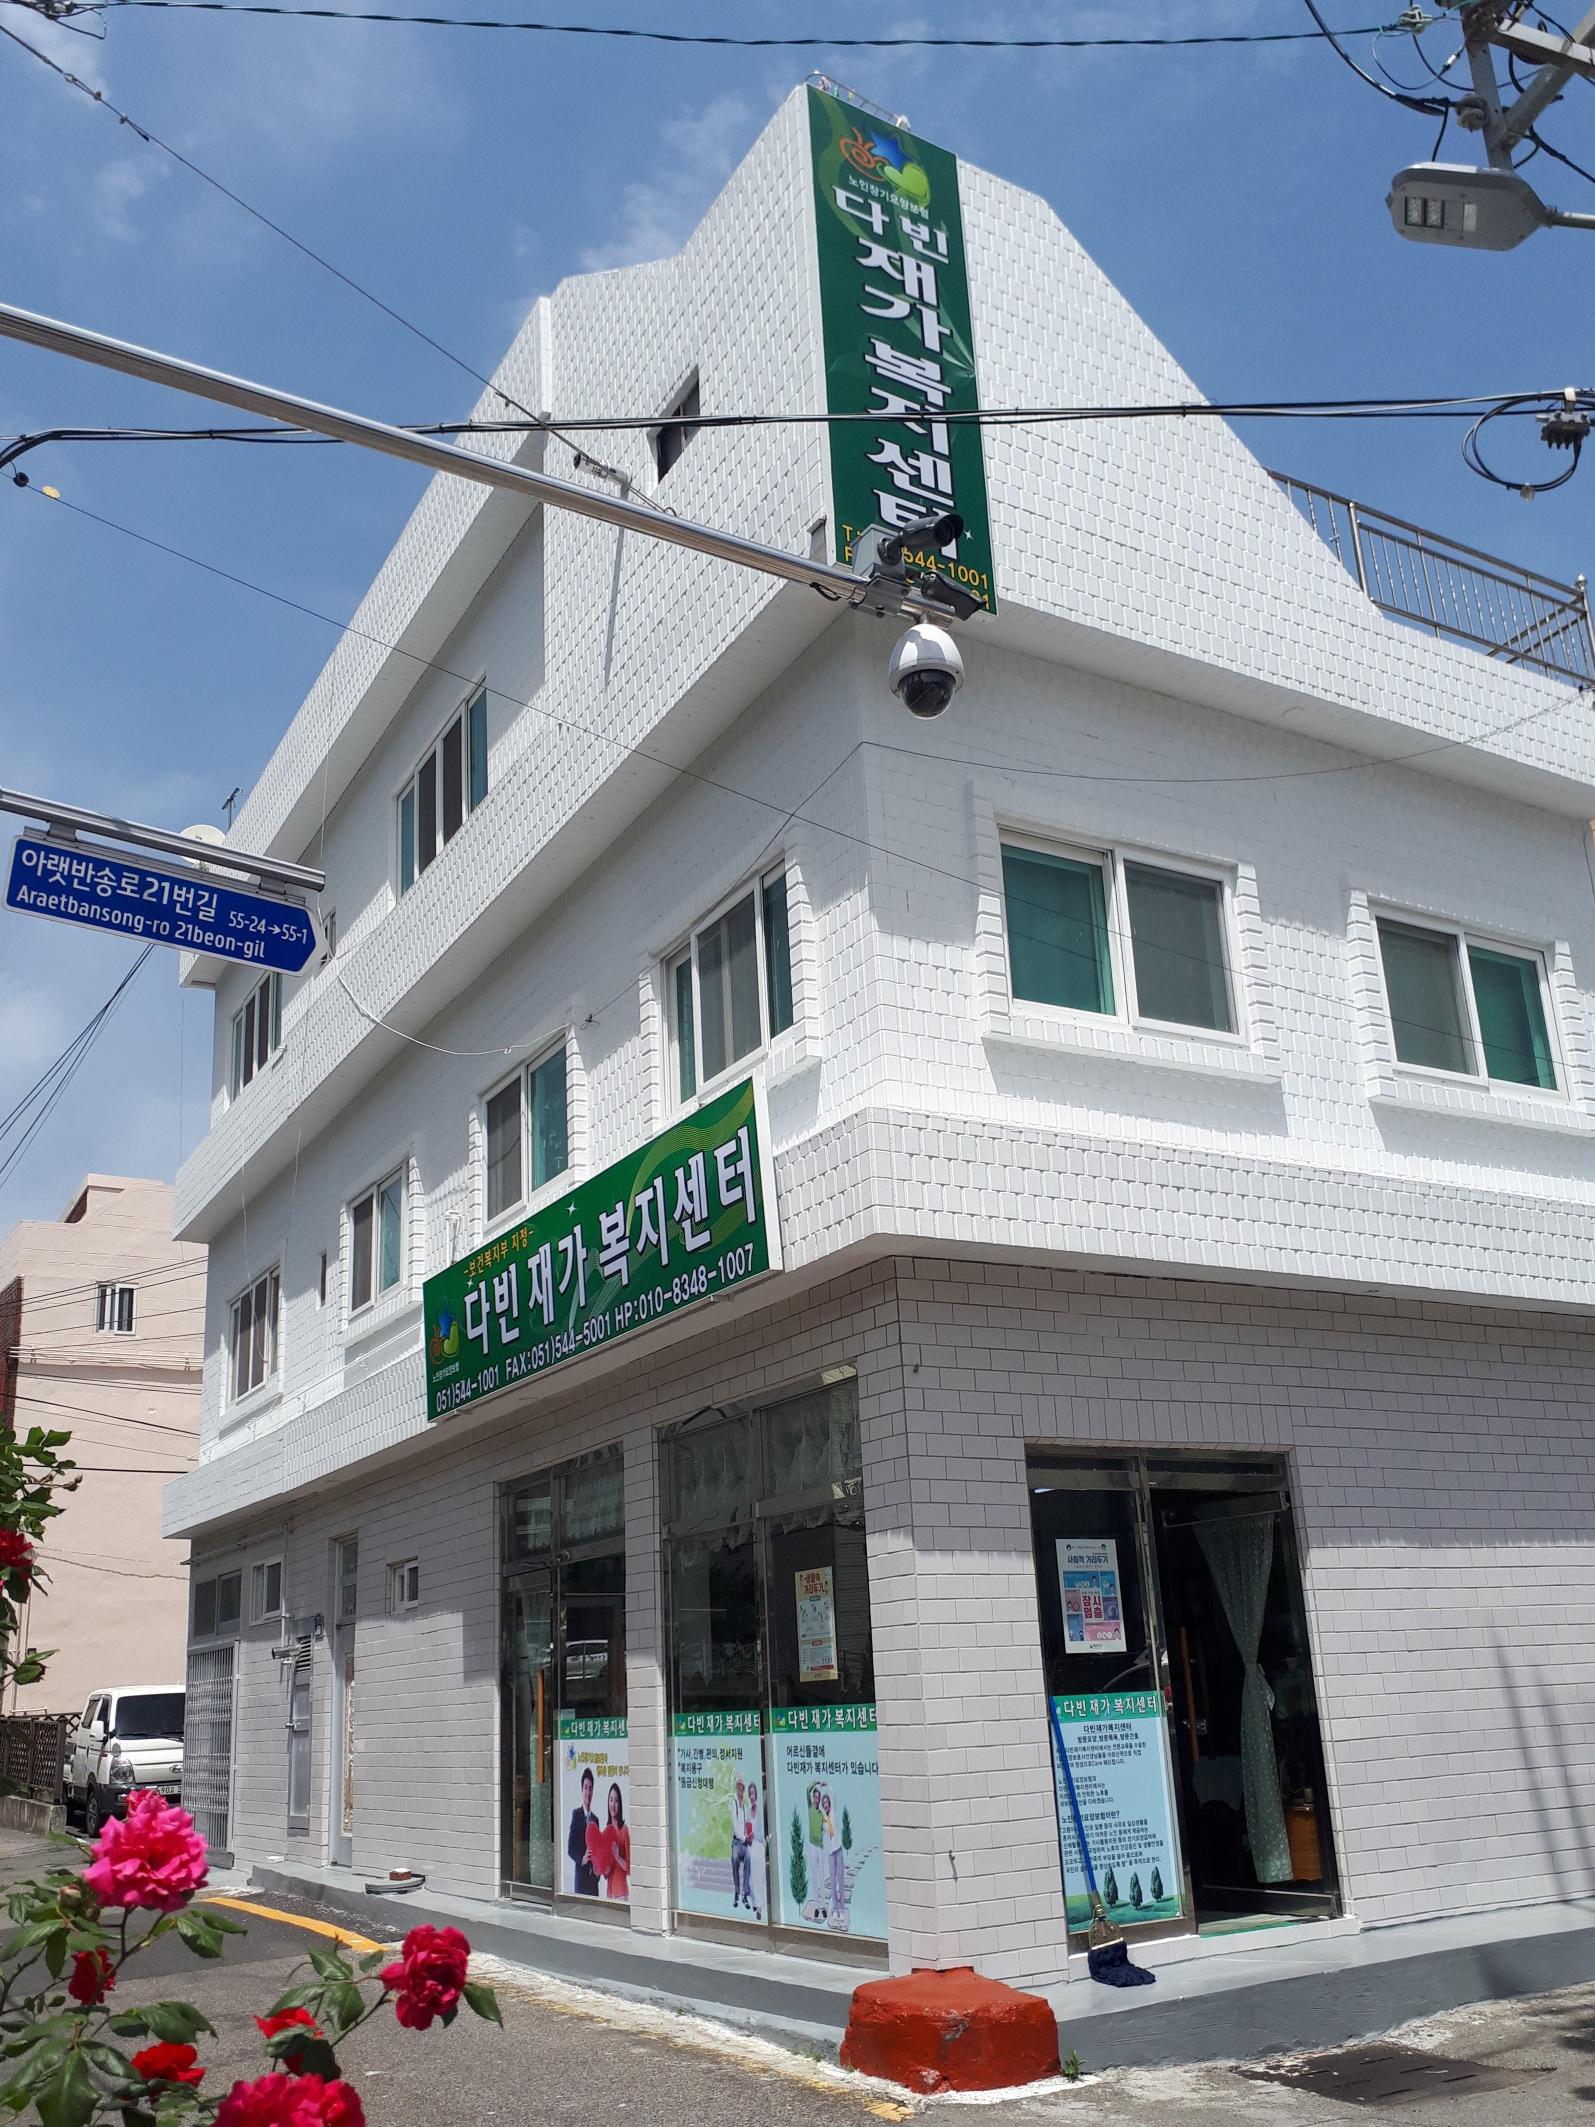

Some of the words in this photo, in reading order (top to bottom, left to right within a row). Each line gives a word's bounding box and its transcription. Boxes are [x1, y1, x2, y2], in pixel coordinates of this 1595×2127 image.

[832, 186, 949, 264] 다빈
[848, 174, 929, 220] 노인장기요양보험
[855, 237, 952, 353] 재가
[864, 336, 958, 560] 복지센터
[16, 885, 169, 936] Araetbansong-ro
[174, 921, 265, 959] 21beon-gil
[21, 848, 218, 923] 아랫반송로21번길
[464, 1263, 520, 1354] 다빈
[527, 1224, 588, 1326] 재가
[598, 1125, 757, 1286] 복지센터
[436, 1364, 499, 1412] 051)544-1001
[506, 1311, 611, 1380] FAX:051)544-5001
[615, 1243, 754, 1331] HP:010-8348-1007
[687, 1715, 704, 1733] 다빈
[706, 1714, 723, 1733] 재가
[788, 1710, 809, 1730] 다빈
[811, 1708, 832, 1729] 재가
[1063, 1700, 1087, 1717] 다빈
[1090, 1698, 1111, 1716] 재가
[1114, 1695, 1157, 1715] 복지센터
[1083, 1722, 1132, 1733] 다빈재가복지센터
[787, 1761, 813, 1775] 다빈재가
[814, 1761, 849, 1775] 복지센터가
